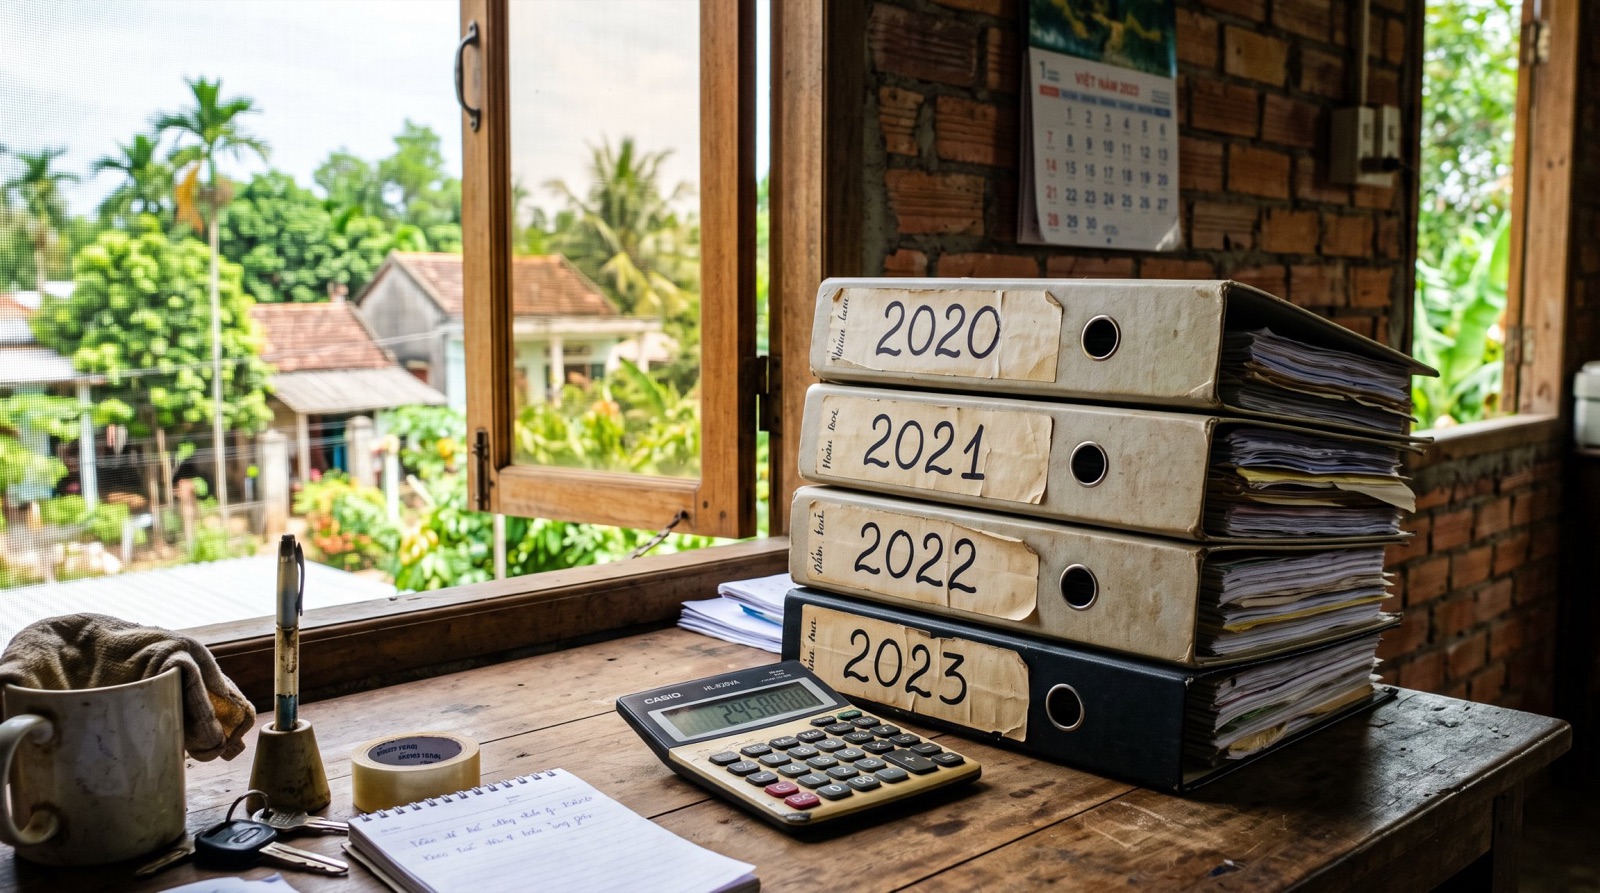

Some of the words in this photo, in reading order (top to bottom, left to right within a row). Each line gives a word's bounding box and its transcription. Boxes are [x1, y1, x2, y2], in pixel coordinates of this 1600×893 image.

[1086, 110, 1091, 124] 2
[875, 300, 1001, 359] 2020
[863, 413, 985, 481] 2021
[854, 521, 977, 594] 2022
[843, 628, 967, 705] 2023
[644, 692, 682, 705] CASIO
[776, 783, 790, 791] C
[854, 775, 874, 785] 00
